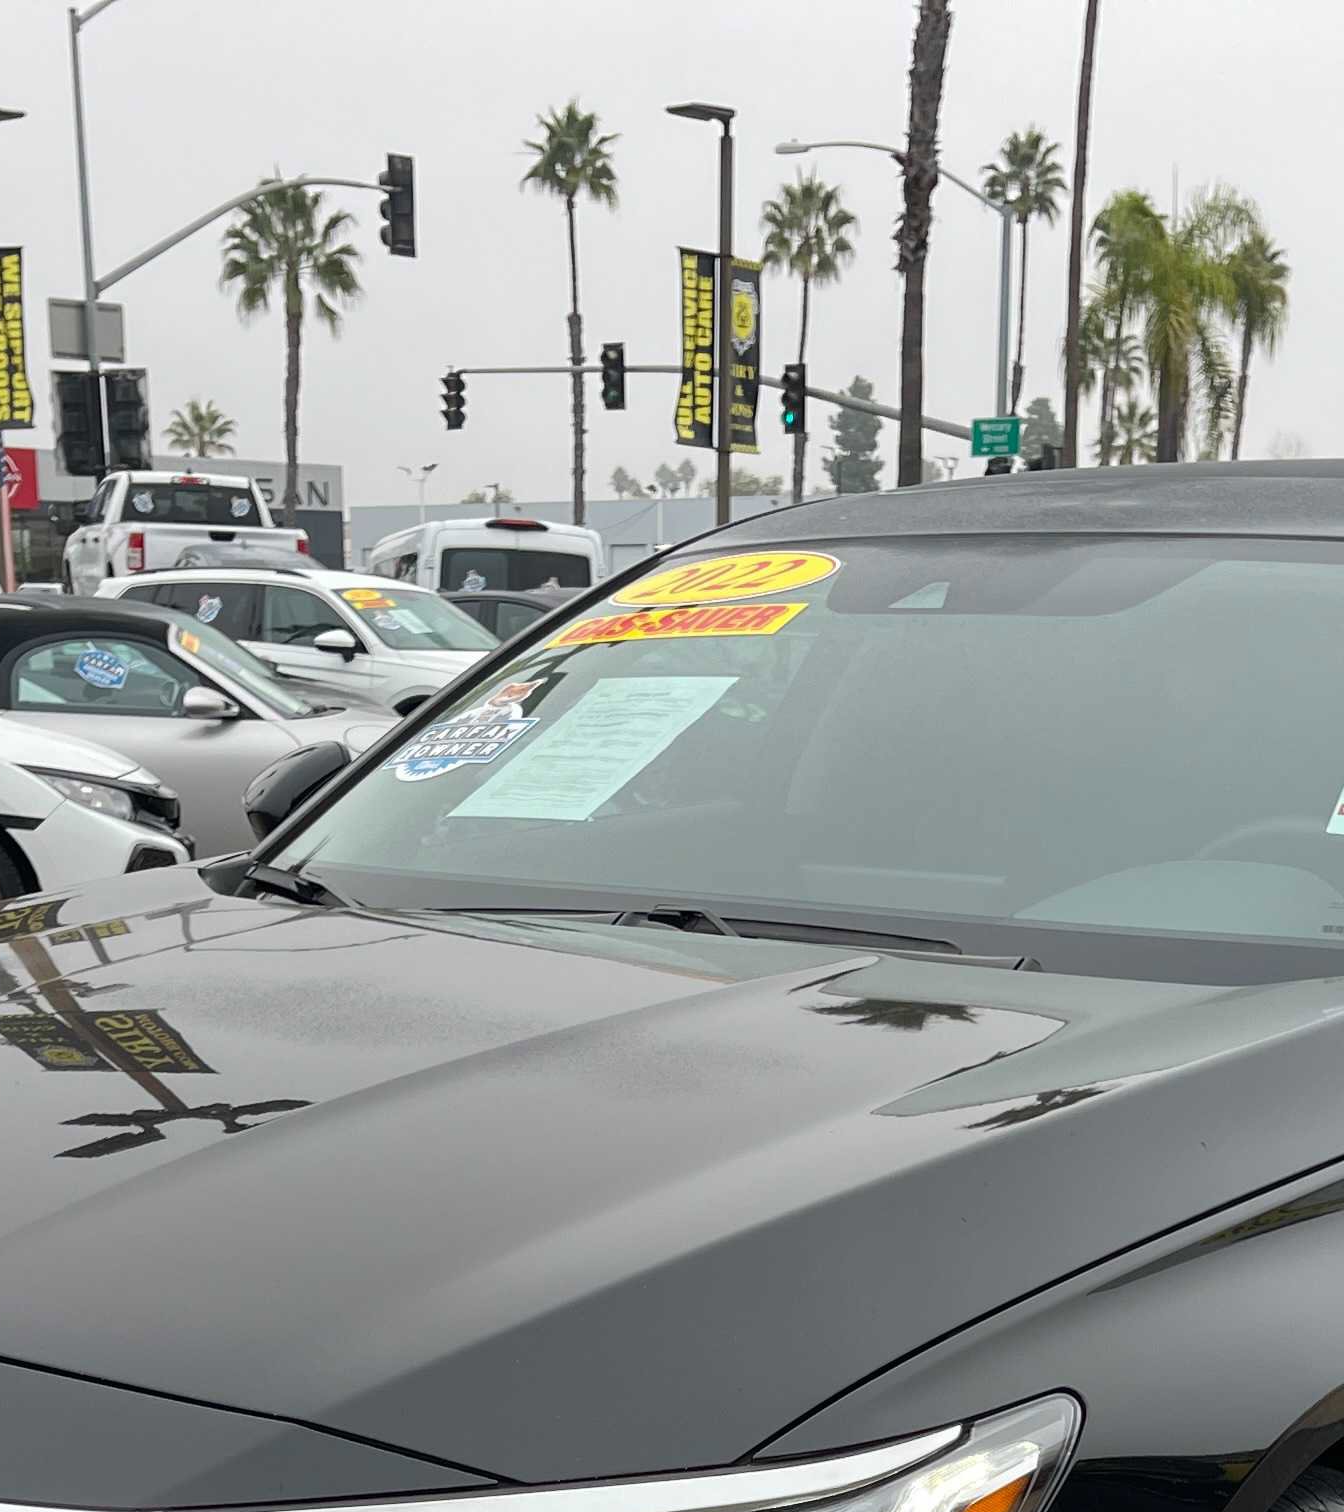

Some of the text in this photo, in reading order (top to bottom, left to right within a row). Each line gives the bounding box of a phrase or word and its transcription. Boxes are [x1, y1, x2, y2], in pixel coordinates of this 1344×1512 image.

[1, 253, 22, 297] WE
[694, 276, 713, 424] AUTO CARE
[676, 381, 696, 439] FULL
[632, 558, 808, 599] 2022
[419, 724, 524, 743] CARFAX
